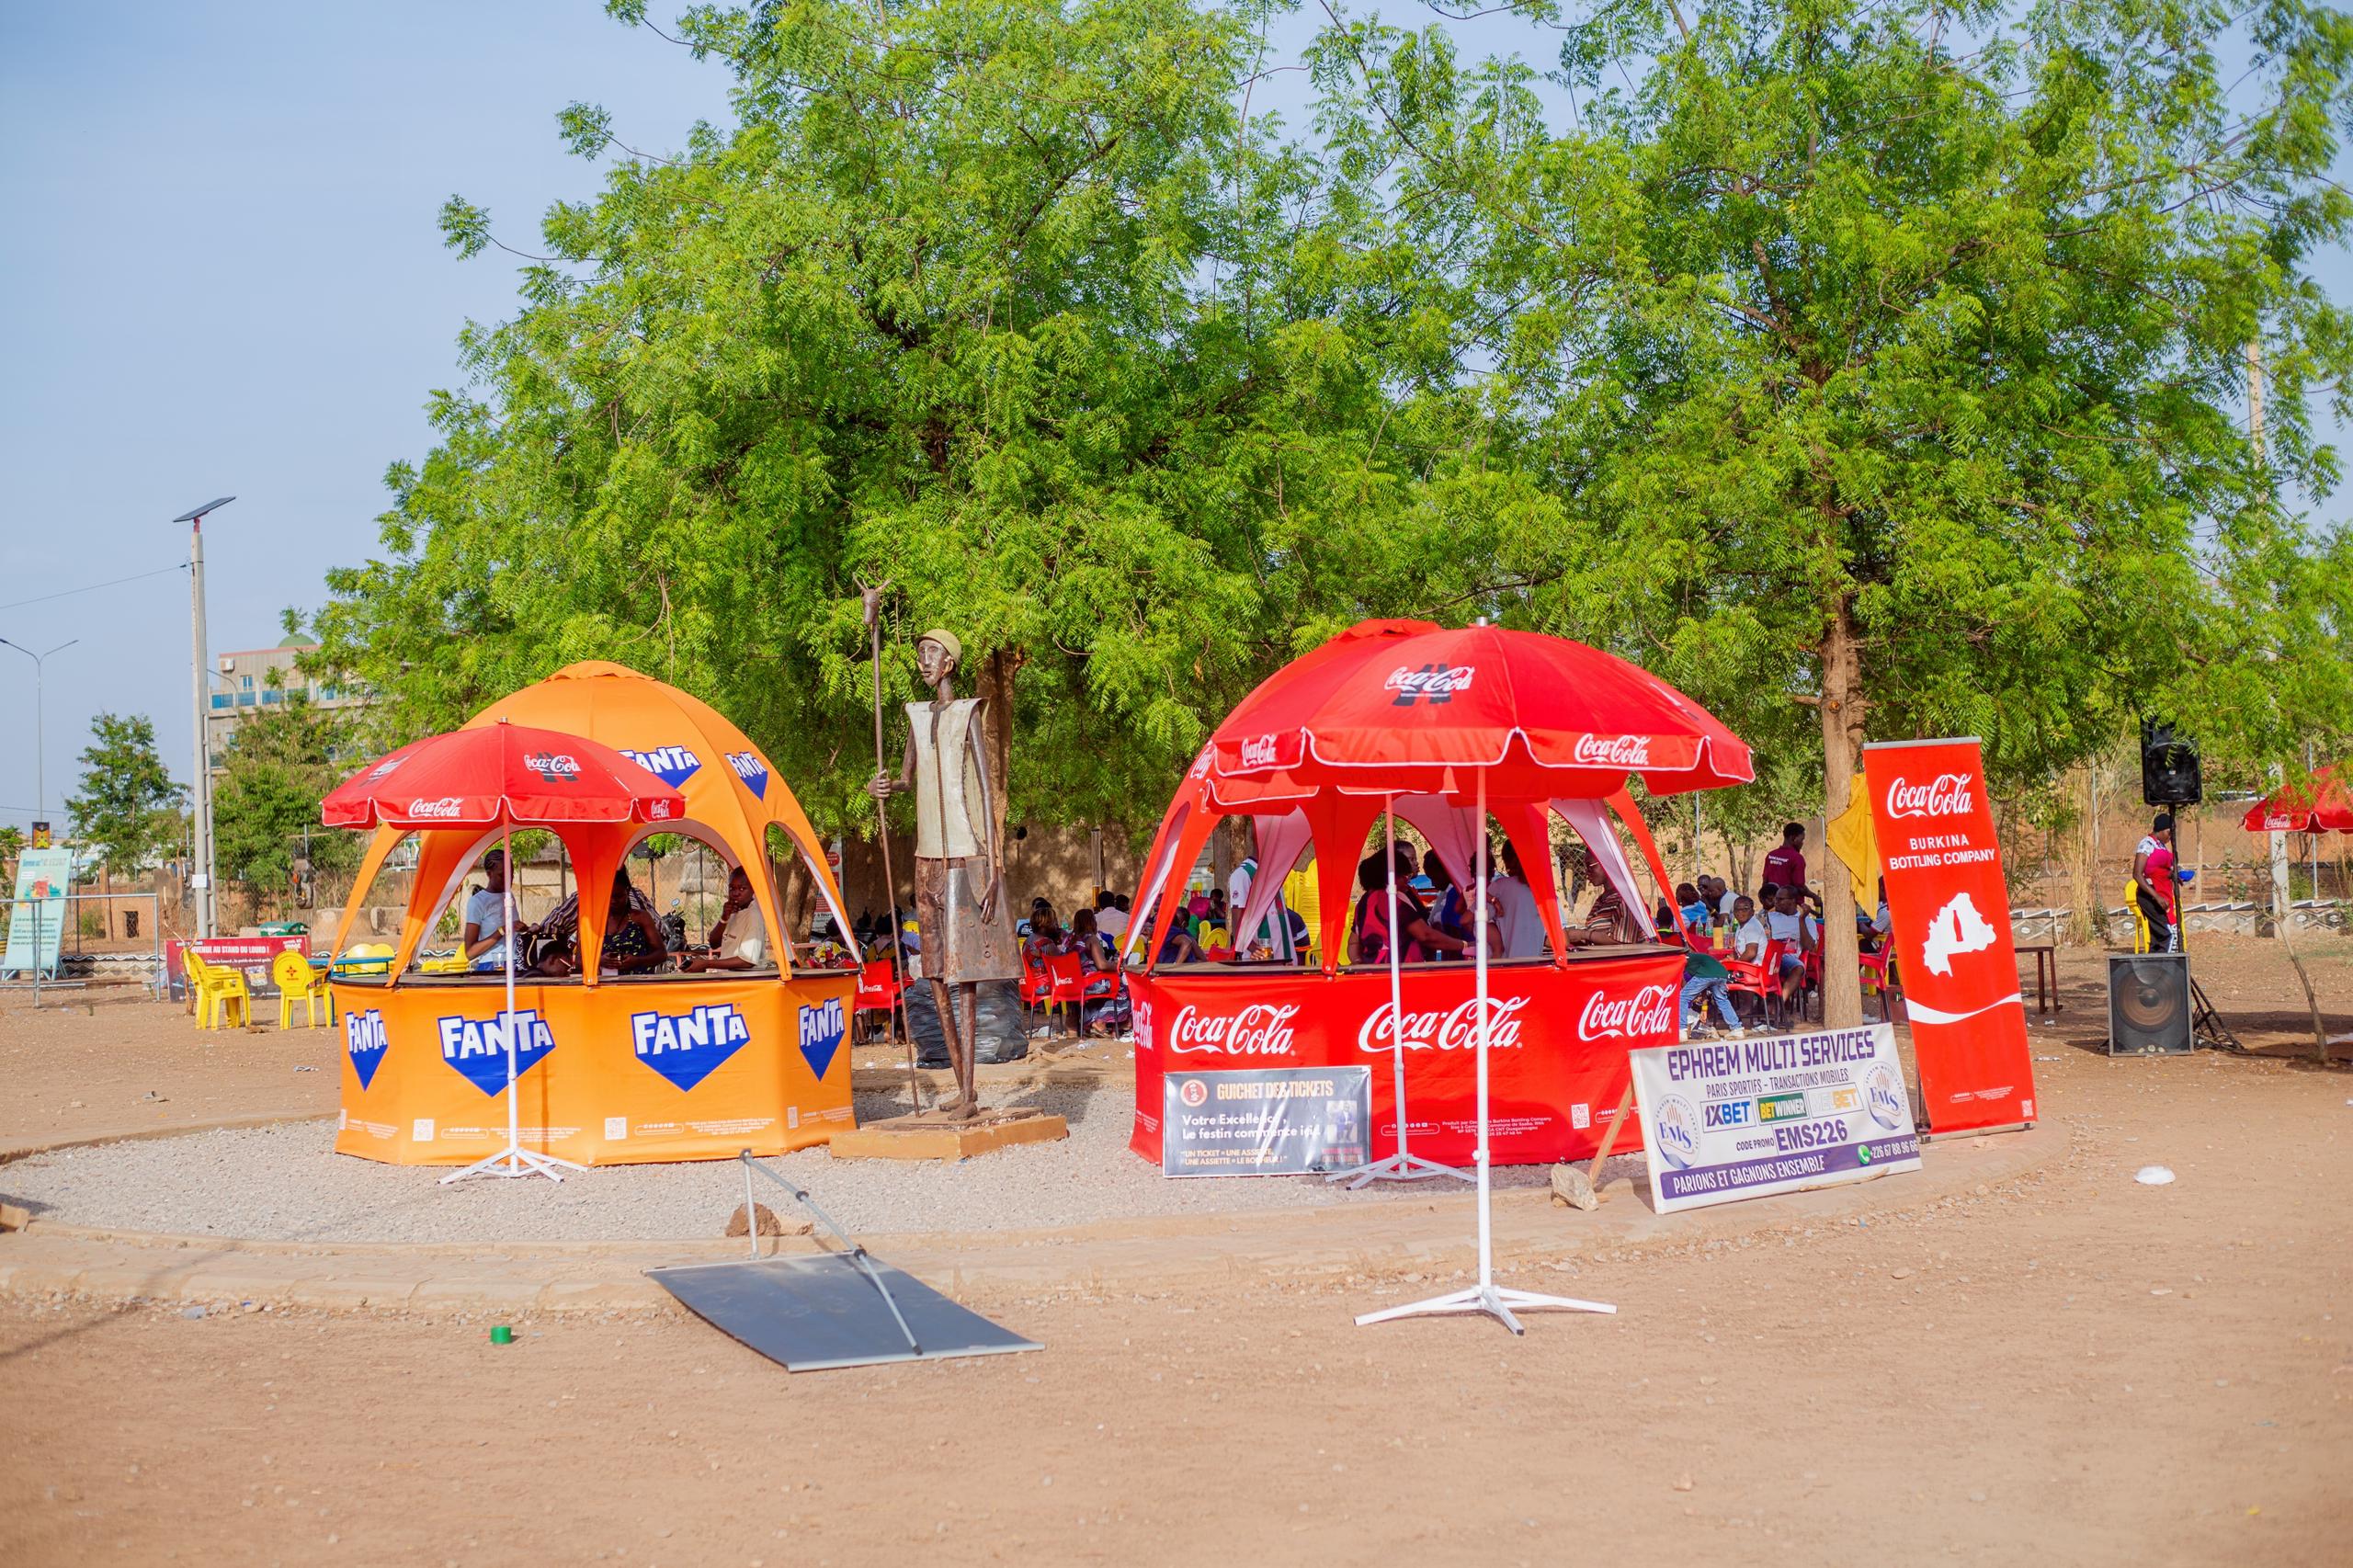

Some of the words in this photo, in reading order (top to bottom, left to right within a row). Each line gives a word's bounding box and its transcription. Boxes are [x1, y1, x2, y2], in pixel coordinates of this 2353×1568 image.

[1384, 665, 1475, 692] Coca-Cola
[1243, 734, 1277, 767] Coca-Cola
[1574, 733, 1652, 765] Coca-Cola
[524, 754, 580, 773] Coca-Cola
[725, 752, 767, 778] FANTA
[408, 798, 463, 818] Coca-Cola
[651, 799, 670, 818] Coca-Cola
[1887, 773, 1972, 818] Coca-Cola
[1910, 835, 1970, 851] BURKINA
[1890, 852, 1942, 869] BOTTLING
[1944, 848, 1995, 865] COMPANY
[800, 1000, 845, 1046] FANTA
[1358, 996, 1530, 1052] Coca-Cola
[1578, 984, 1677, 1042] Coca-Cola
[347, 1011, 387, 1052] FANTA
[438, 1011, 552, 1058] FANTA
[632, 1006, 748, 1054] FANTA
[1170, 1005, 1301, 1055] Coca-Cola
[1668, 1044, 1740, 1081] EPHREM
[1746, 1038, 1797, 1073] MULTI
[1802, 1030, 1875, 1067] SERVICES
[1217, 1083, 1264, 1100] GUICHET
[1289, 1080, 1334, 1097] TICKETS
[1707, 1083, 1728, 1098] PARIS
[1729, 1078, 1762, 1096] SPORTIFS
[1768, 1073, 1819, 1091] TRANSACTIONS
[1820, 1068, 1848, 1085] MOBILES
[1870, 1086, 1899, 1111] EMS
[1182, 1115, 1216, 1125] Votre
[1220, 1113, 1280, 1125] Excellec
[1706, 1101, 1750, 1127] 1XBET
[1183, 1128, 1196, 1140] Le
[1199, 1128, 1232, 1140] festin
[1234, 1128, 1297, 1139] commence
[1659, 1121, 1691, 1149] EMS
[1736, 1142, 1753, 1152] CODE
[1754, 1138, 1775, 1149] PROMO
[1775, 1119, 1847, 1151] EMS226
[1185, 1157, 1199, 1165] UNE
[1200, 1157, 1230, 1165] ASSIETTE
[1245, 1155, 1279, 1165] BOHEUR
[1197, 1149, 1220, 1157] TICKET
[1870, 1145, 1884, 1158] +226
[1883, 1143, 1892, 1156] 67
[1674, 1173, 1716, 1194] PARIONS
[1718, 1170, 1730, 1186] ET
[1731, 1163, 1777, 1186] GAGNONS
[1779, 1155, 1825, 1178] ENSEMBLE
